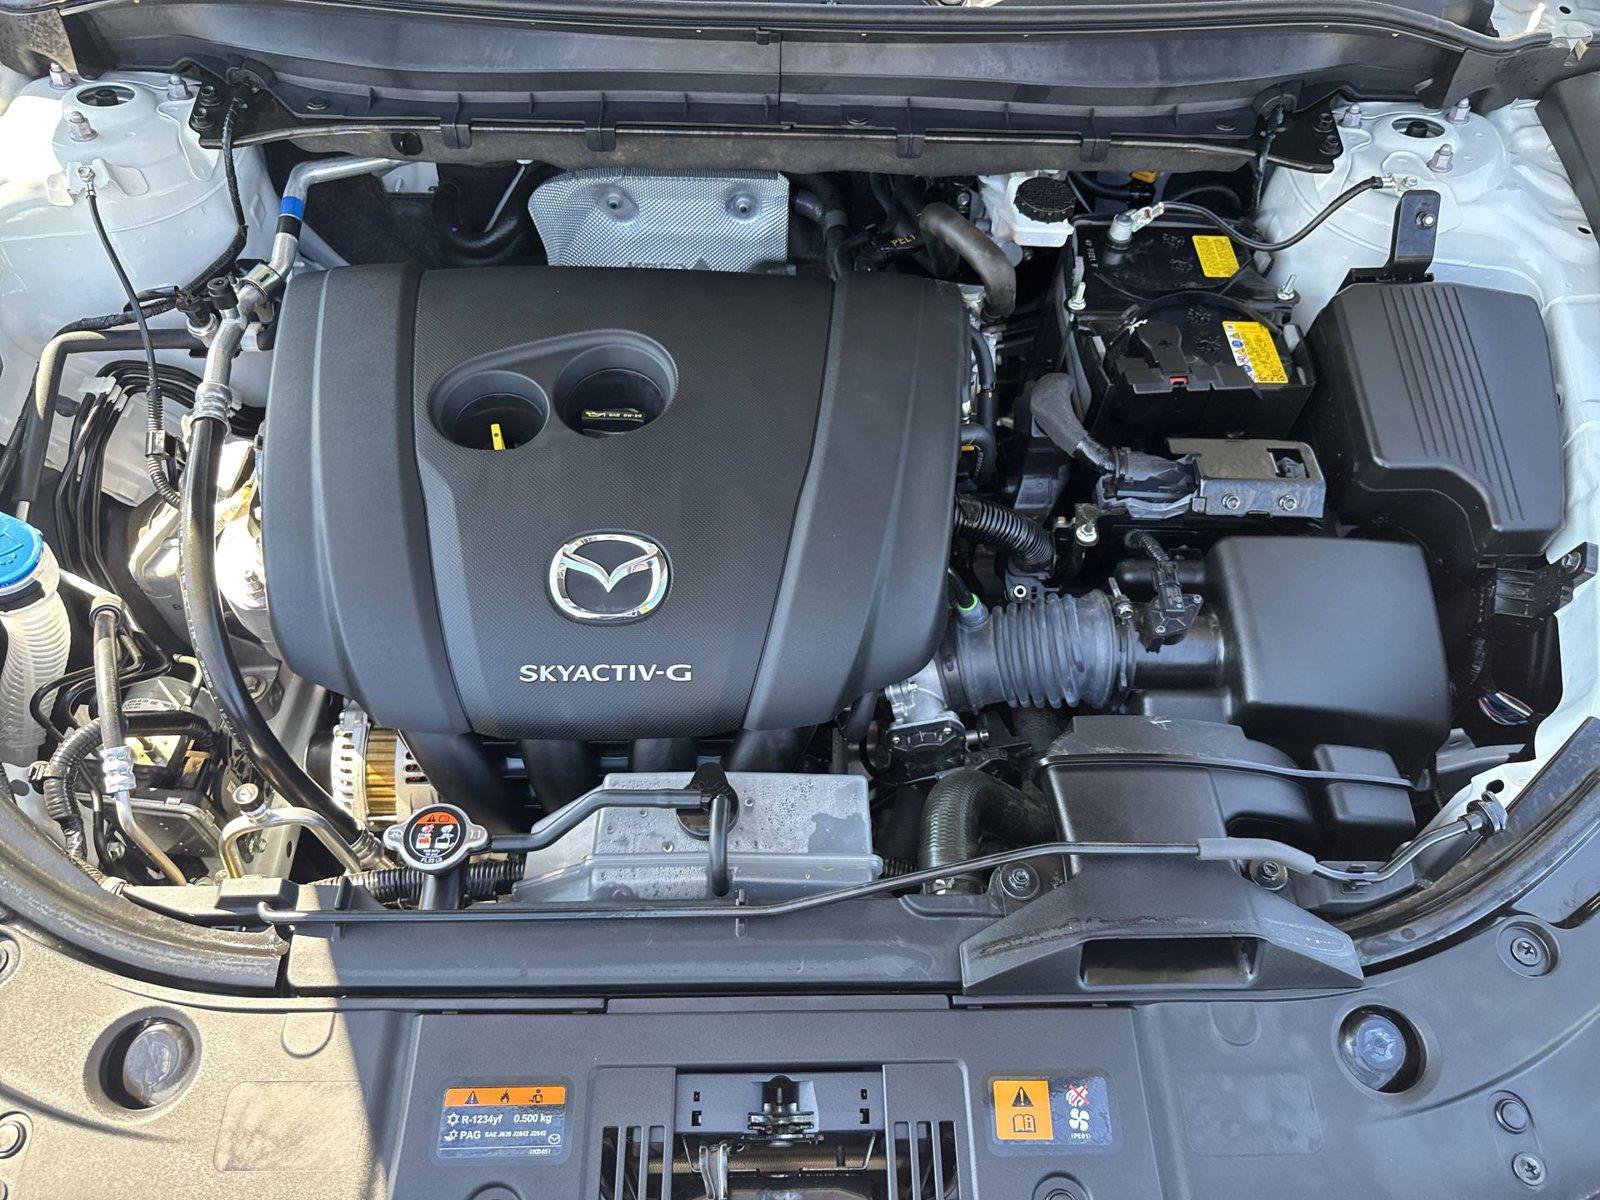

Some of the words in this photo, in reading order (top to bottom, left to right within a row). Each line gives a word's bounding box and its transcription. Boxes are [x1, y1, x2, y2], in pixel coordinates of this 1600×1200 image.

[519, 664, 692, 682] SKYACTIV-G
[461, 1113, 504, 1126] R-1234yf
[514, 1113, 538, 1123] 0.500
[540, 1113, 552, 1124] kg
[460, 1131, 482, 1140] PAG
